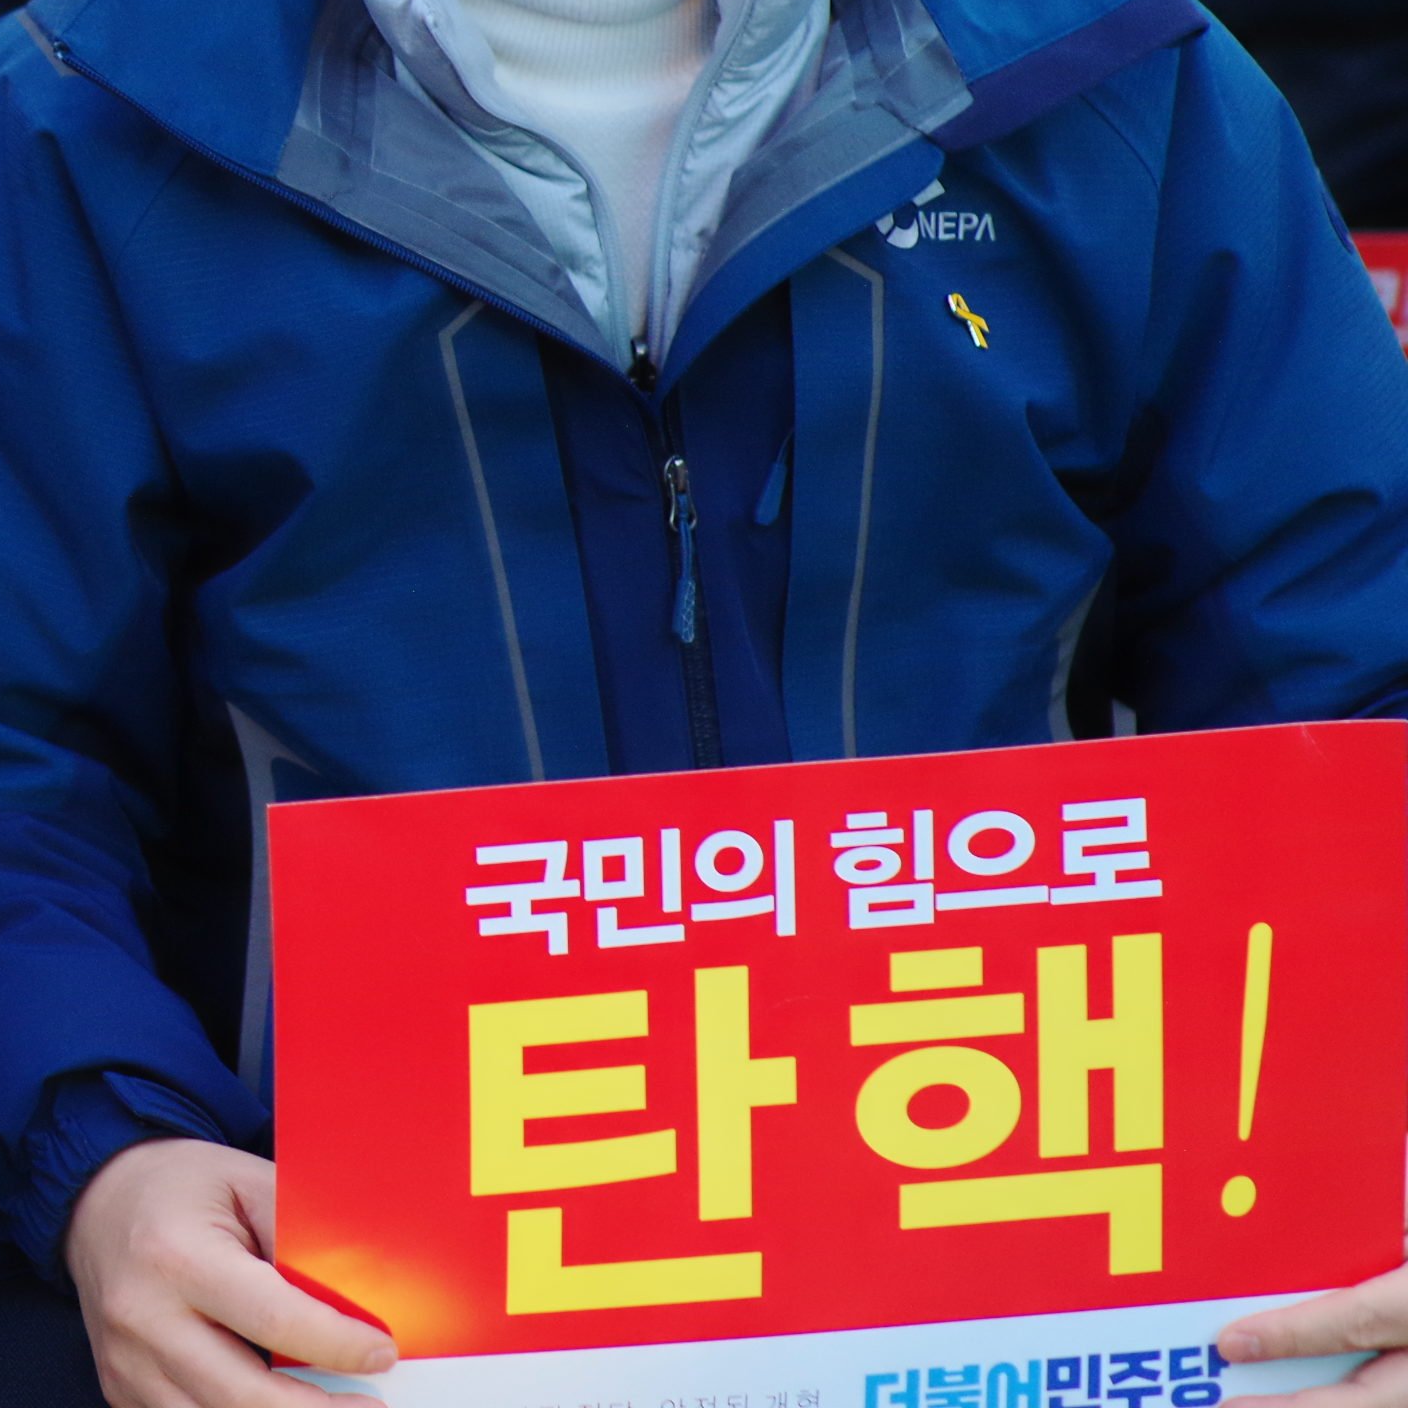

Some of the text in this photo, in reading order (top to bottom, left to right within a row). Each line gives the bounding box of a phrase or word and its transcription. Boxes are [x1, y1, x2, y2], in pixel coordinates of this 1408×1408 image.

[918, 211, 995, 241] NEPA
[465, 797, 1163, 956] 국민의 힘으로
